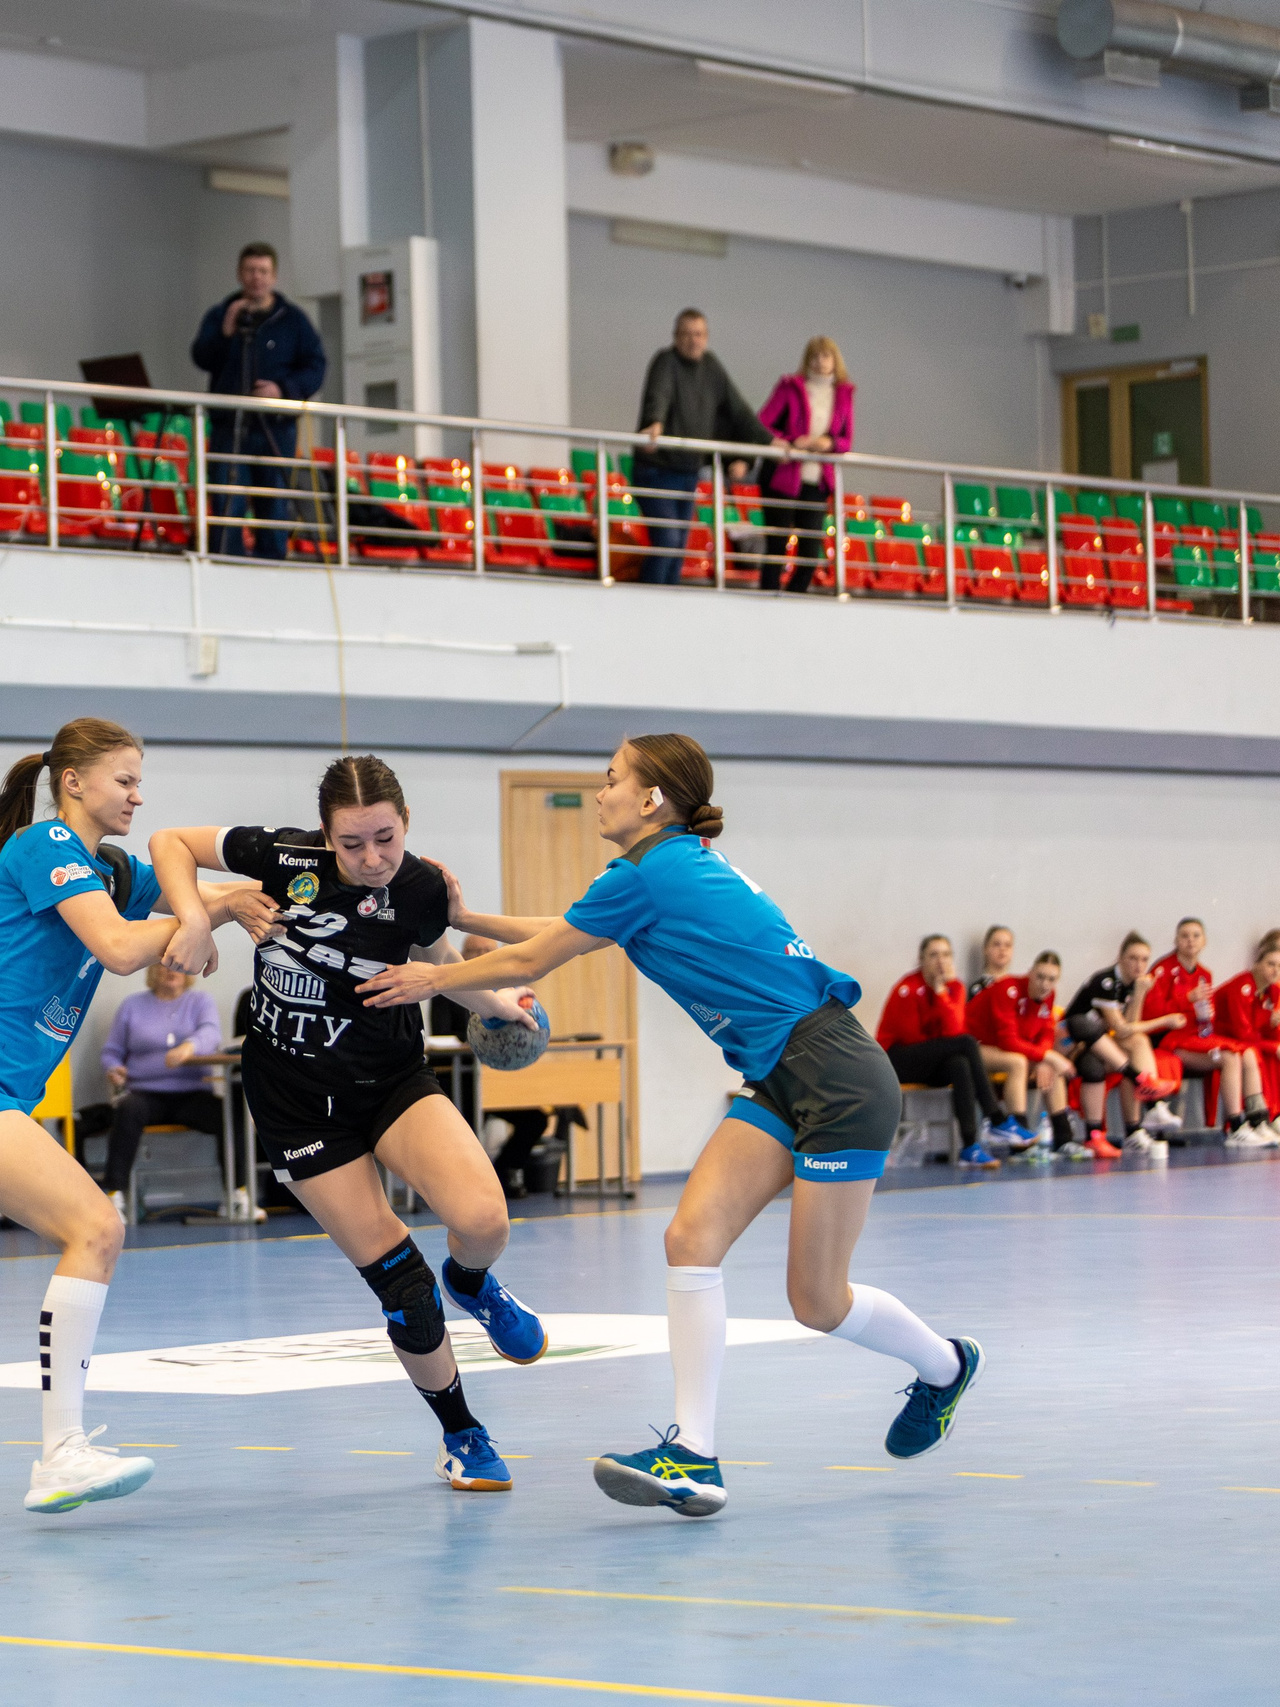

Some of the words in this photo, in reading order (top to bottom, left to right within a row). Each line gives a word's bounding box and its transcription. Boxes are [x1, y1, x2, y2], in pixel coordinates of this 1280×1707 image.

[278, 853, 318, 869] Kempa
[266, 1036, 296, 1056] 920
[283, 1140, 324, 1161] Kempa
[803, 1156, 848, 1172] Kempa
[381, 1247, 411, 1270] Kempa
